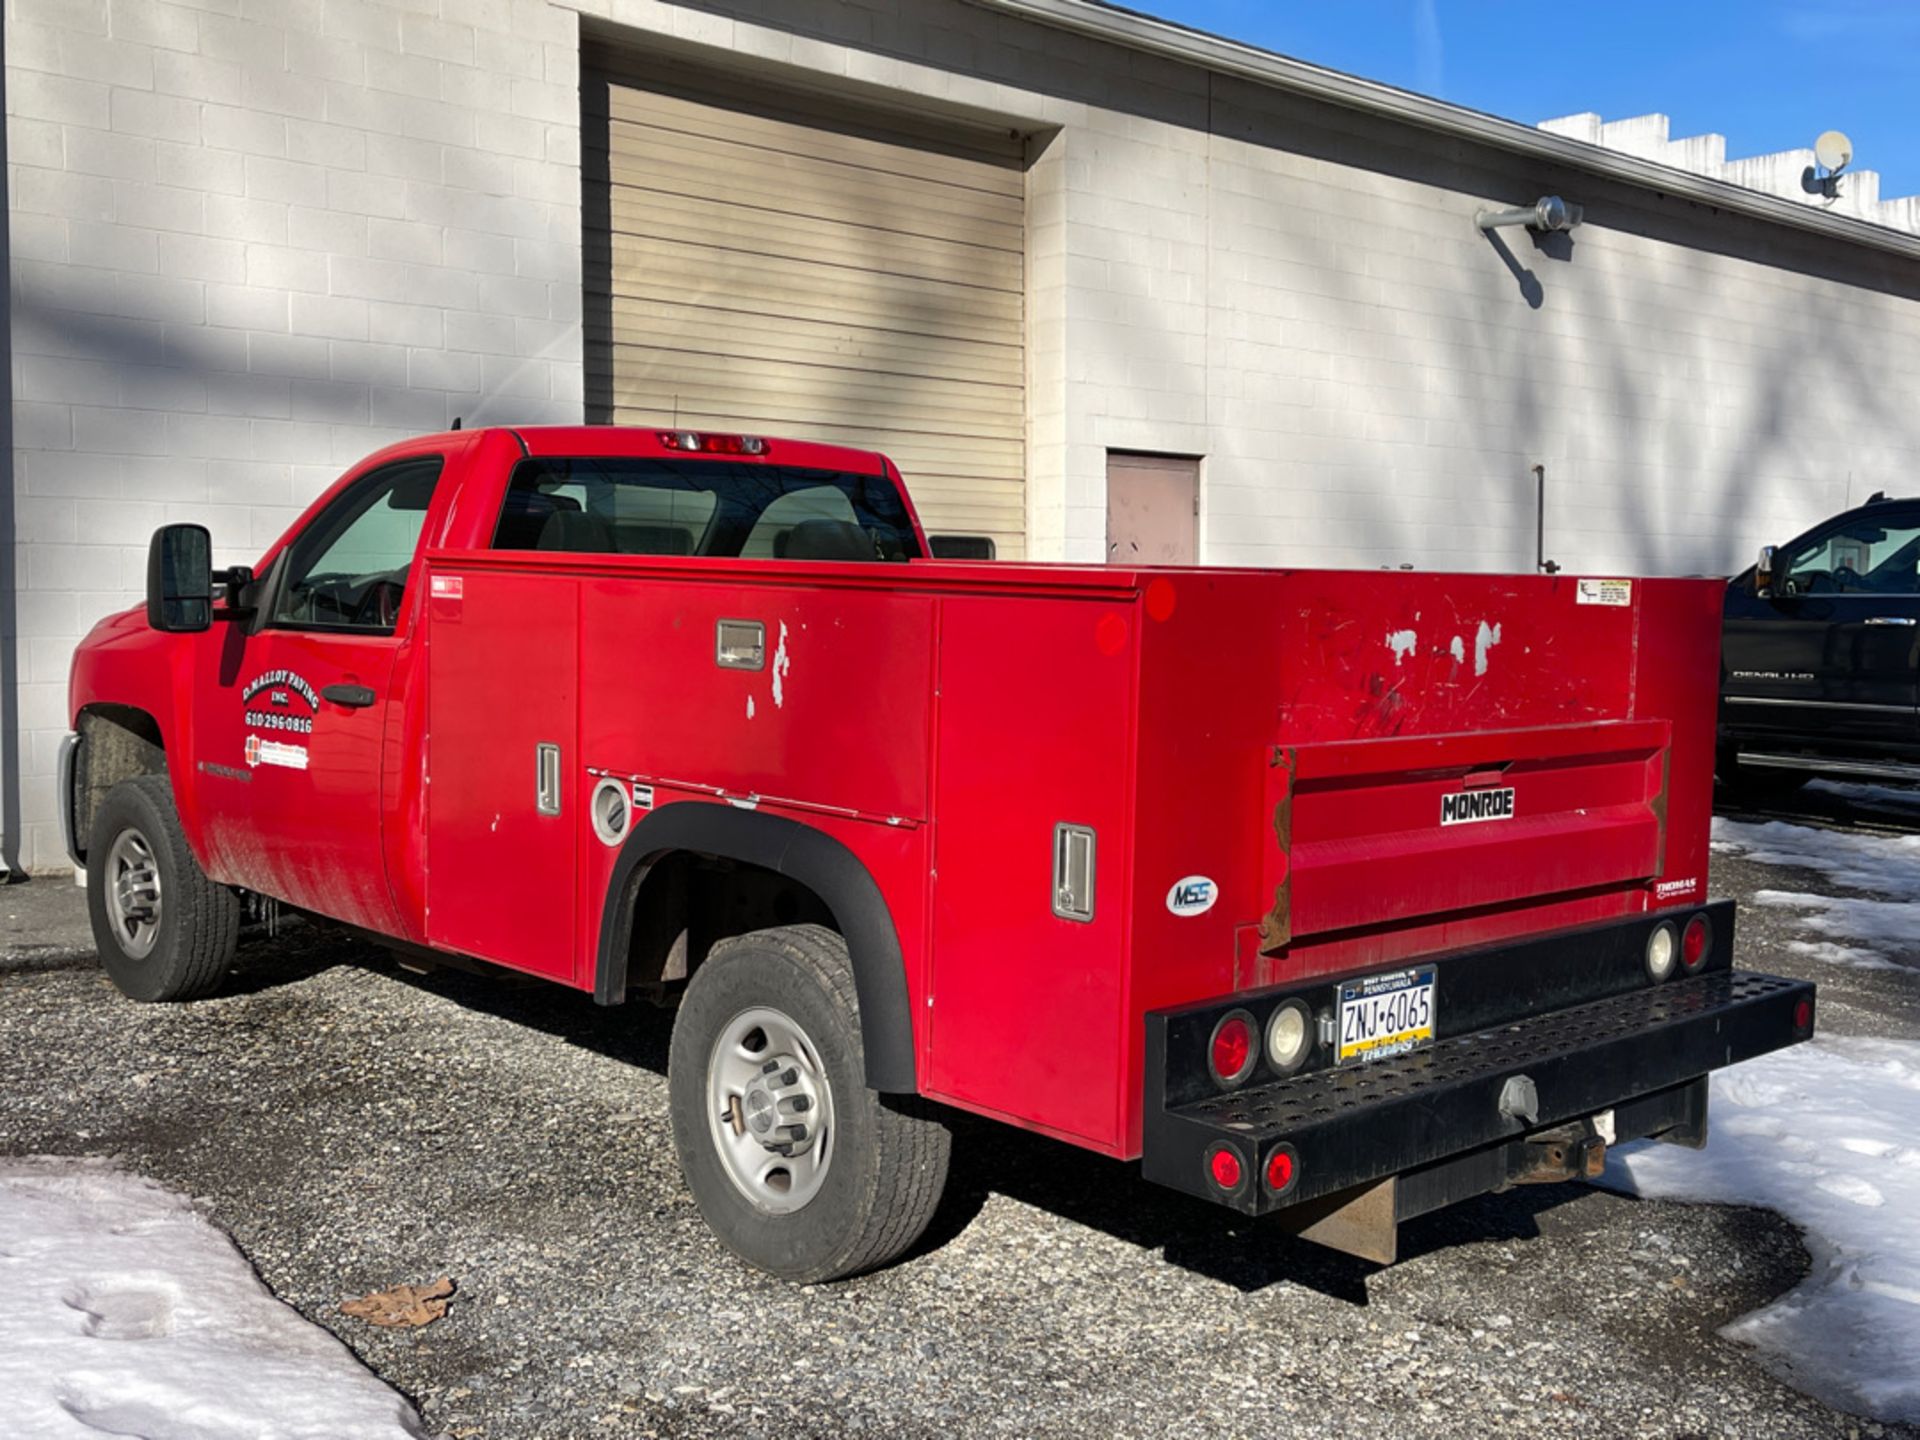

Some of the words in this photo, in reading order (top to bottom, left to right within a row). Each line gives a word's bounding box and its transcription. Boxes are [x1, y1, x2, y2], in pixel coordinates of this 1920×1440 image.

[287, 672, 319, 708] PAVING
[1443, 789, 1514, 822] MONROE
[1656, 878, 1697, 893] THOMAS
[1364, 978, 1412, 996] PENNSYLVANIA
